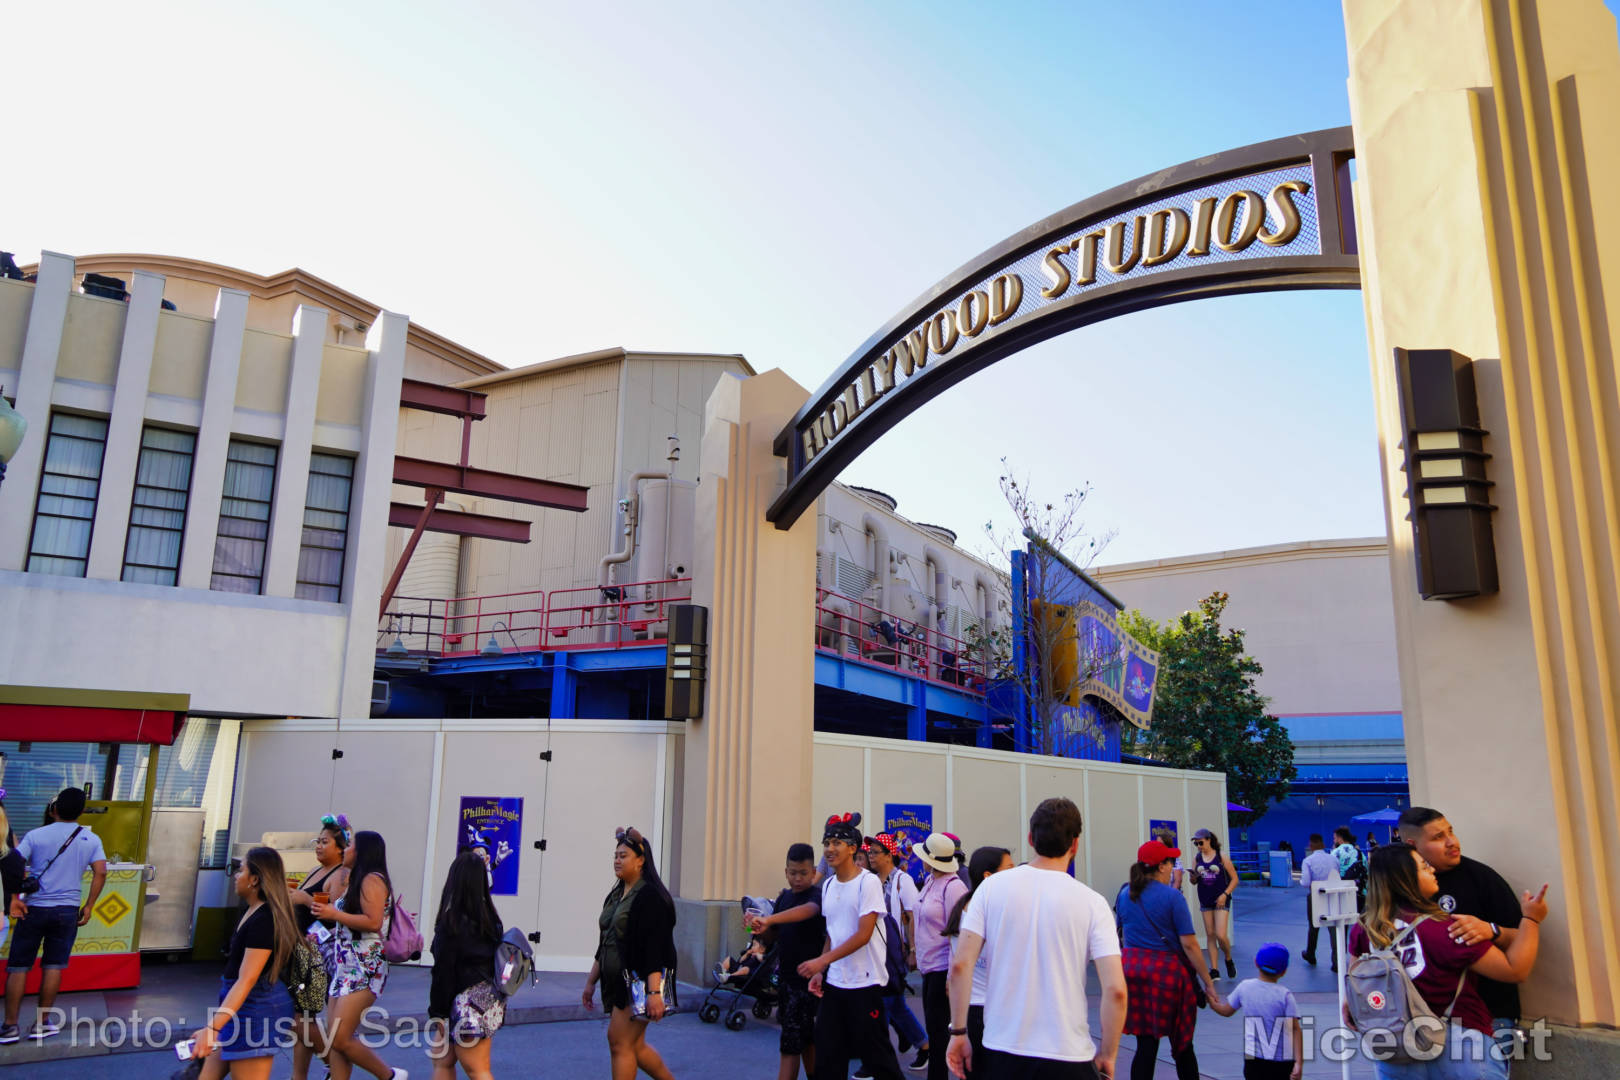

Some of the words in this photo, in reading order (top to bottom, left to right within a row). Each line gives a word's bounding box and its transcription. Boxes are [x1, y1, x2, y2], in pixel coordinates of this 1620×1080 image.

[802, 273, 1023, 463] HOLLYWOOD
[1041, 180, 1310, 299] STUDIOS
[463, 805, 520, 821] PhilharMagic
